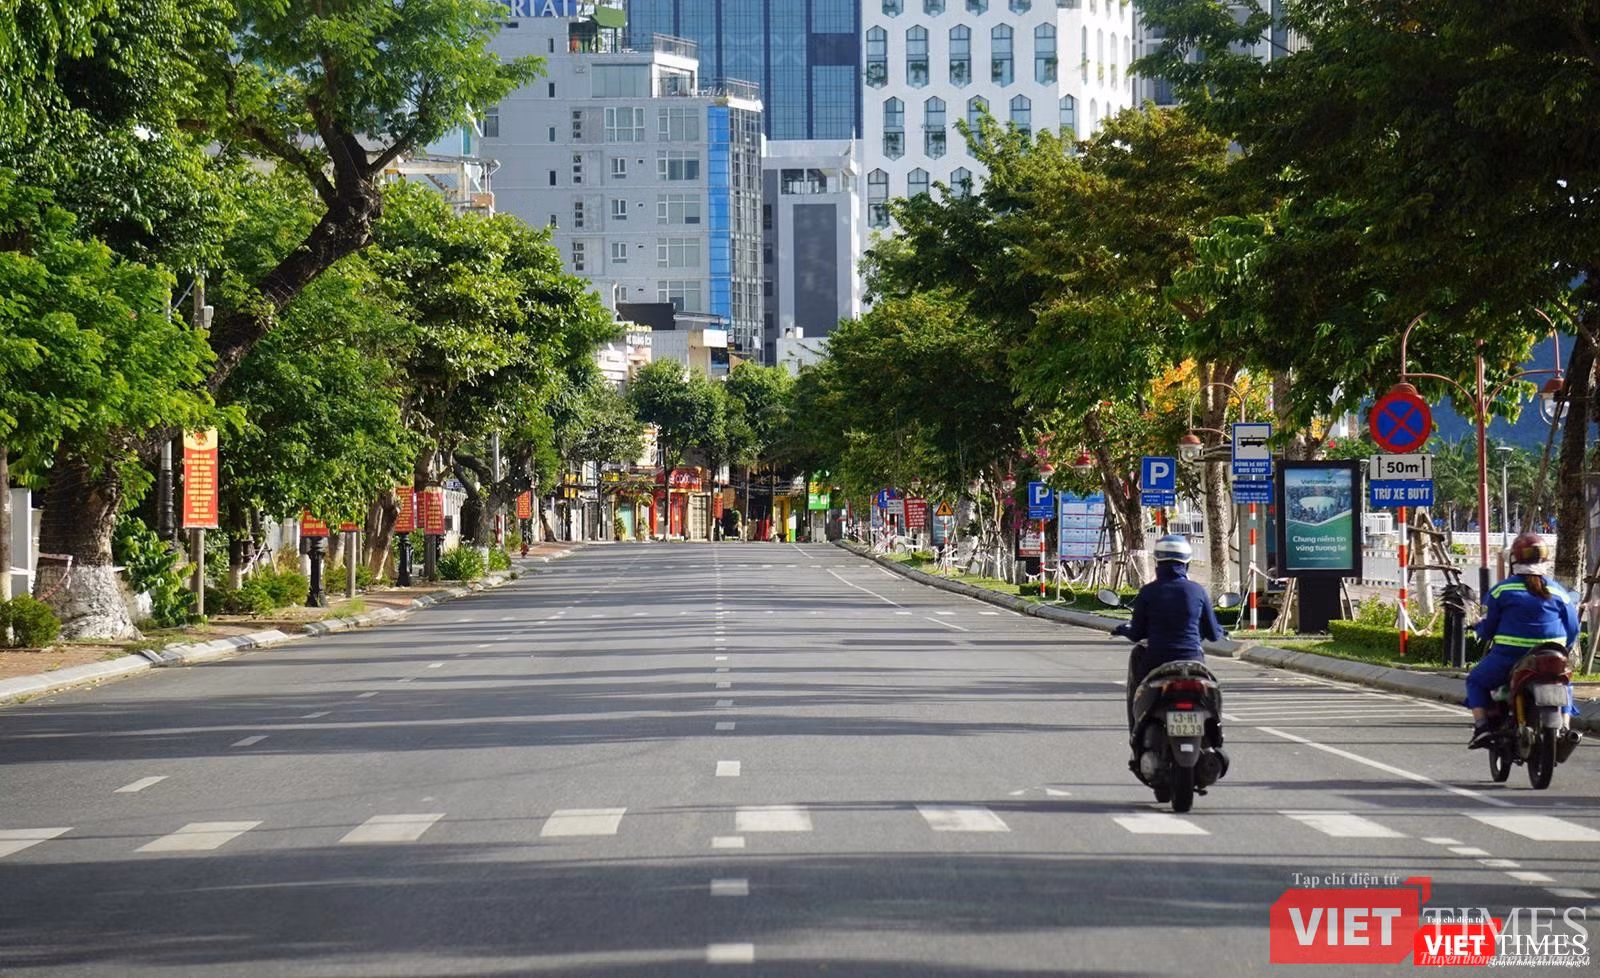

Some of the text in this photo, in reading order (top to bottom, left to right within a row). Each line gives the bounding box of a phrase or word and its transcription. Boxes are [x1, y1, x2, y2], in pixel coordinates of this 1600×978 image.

[1150, 462, 1169, 485] P
[1387, 461, 1418, 473] 50m
[1035, 486, 1050, 504] P
[1393, 487, 1405, 500] XE
[1407, 484, 1430, 500] BUÝT
[1292, 535, 1316, 544] Chung
[1295, 544, 1314, 552] vững
